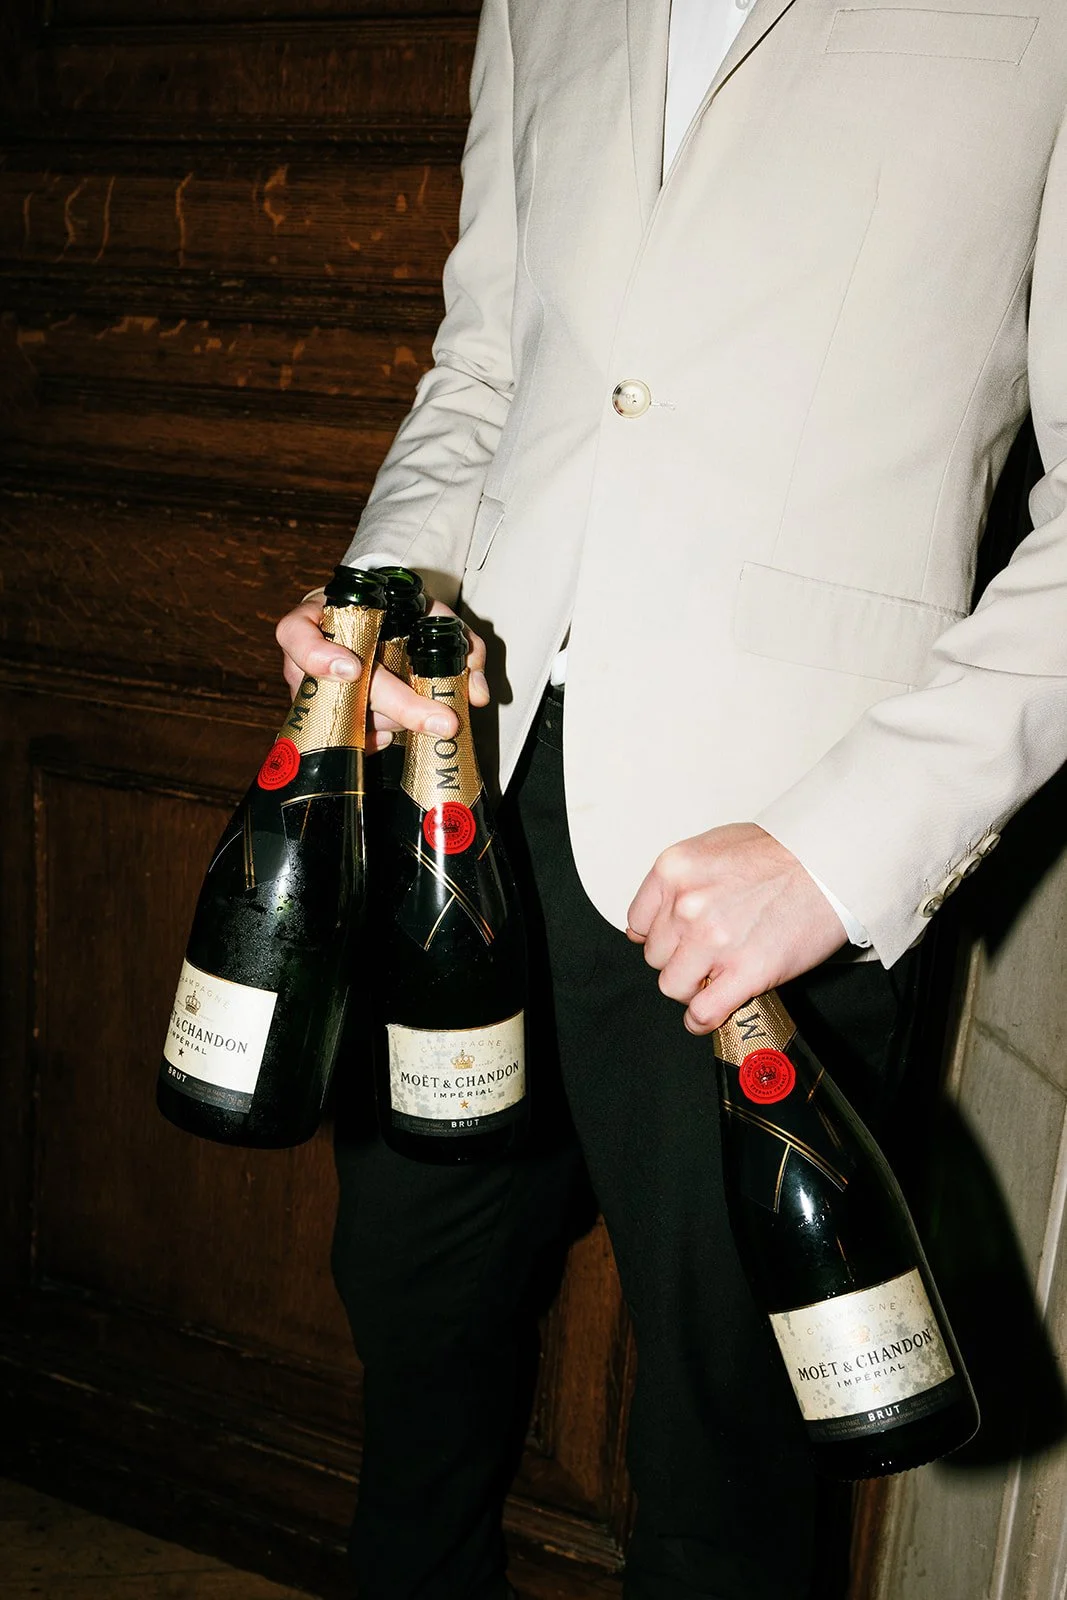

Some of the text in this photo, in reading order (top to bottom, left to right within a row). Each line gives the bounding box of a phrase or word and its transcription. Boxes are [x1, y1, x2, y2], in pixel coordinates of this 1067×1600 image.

[431, 685, 461, 790] MOT
[181, 1020, 248, 1054] CHANDON
[421, 1039, 502, 1054] CHAMPAGNE
[167, 1065, 188, 1083] BRUT
[400, 1071, 440, 1088] MOËT
[442, 1079, 452, 1089] &
[454, 1060, 520, 1089] CHANDON
[433, 1087, 494, 1099] IMPÉRIAL
[451, 1118, 480, 1128] BRUT
[797, 1328, 933, 1382] MOËT & CHANDON
[836, 1362, 906, 1388] IMPÉRIAL
[866, 1404, 902, 1422] BRUT
